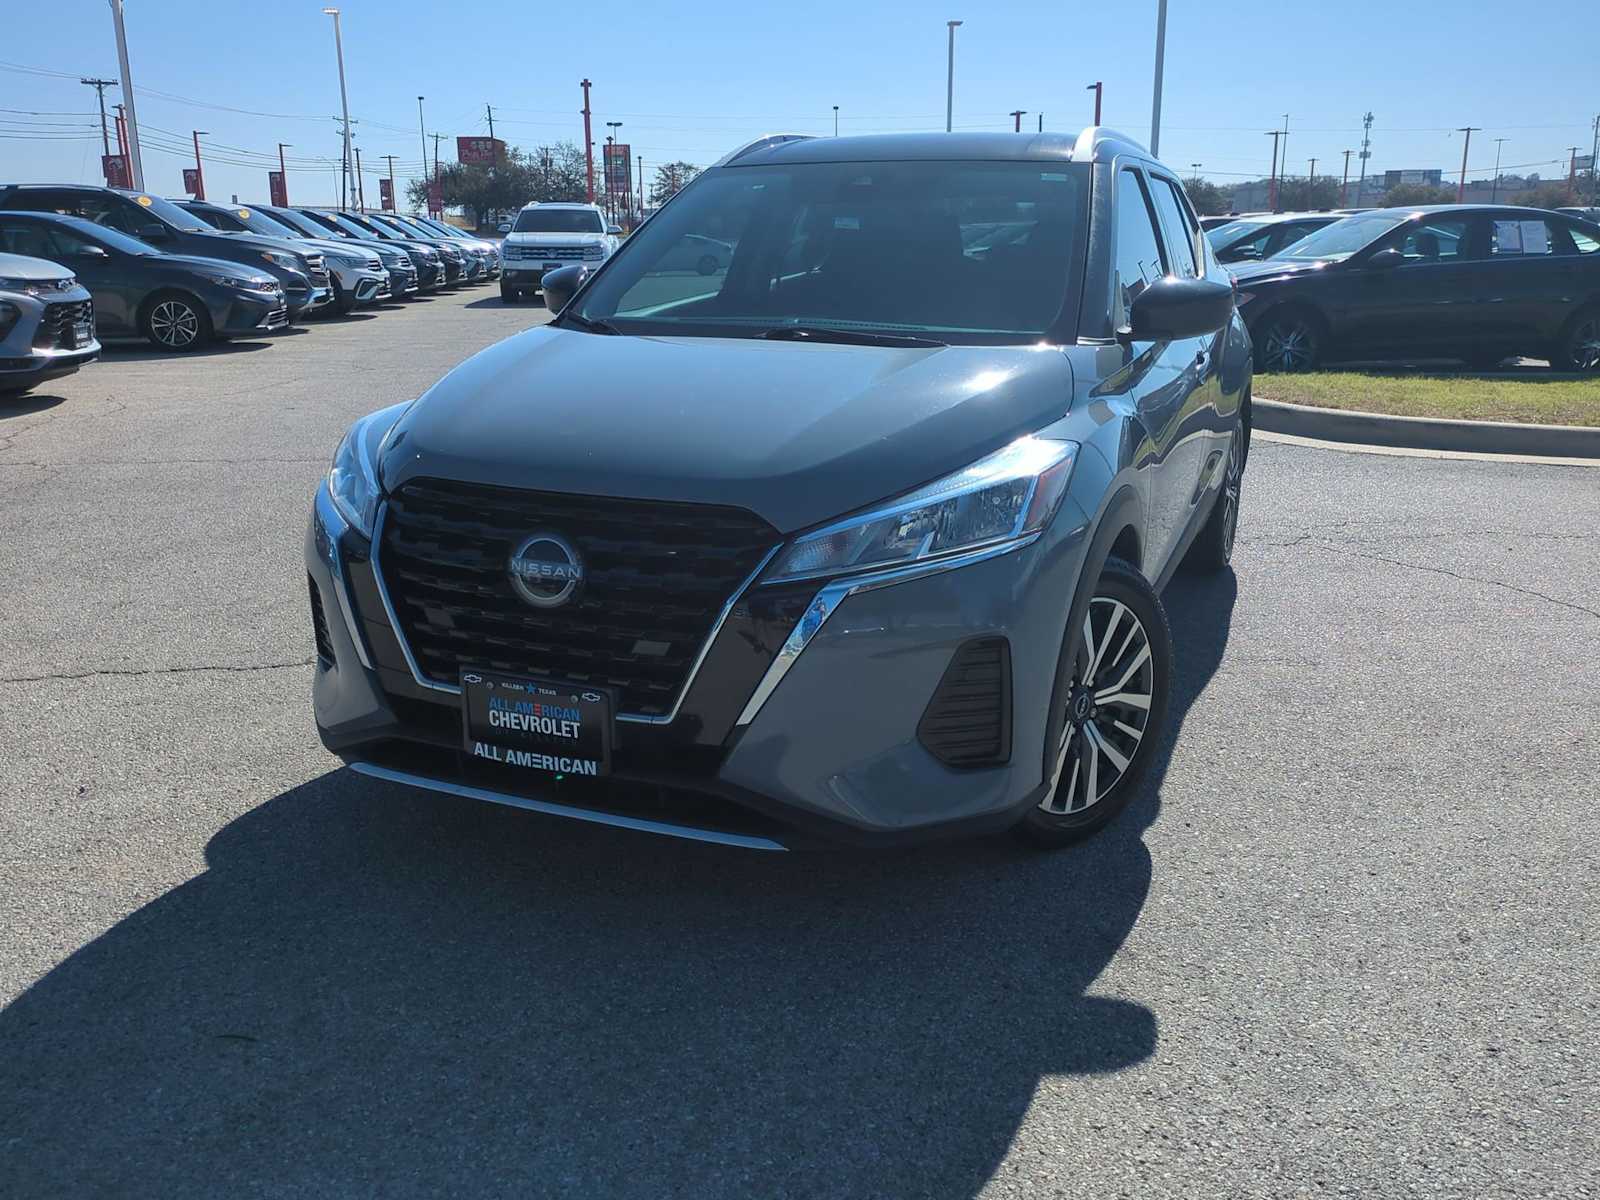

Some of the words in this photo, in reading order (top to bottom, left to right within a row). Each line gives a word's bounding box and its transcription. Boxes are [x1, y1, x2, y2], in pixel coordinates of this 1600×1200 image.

[512, 559, 580, 577] NISSAN
[538, 687, 557, 696] TEXAS
[489, 697, 513, 711] ALL
[515, 701, 581, 721] AMERICAN
[489, 709, 581, 739] CHEVROLET
[474, 742, 503, 762] ALL
[505, 749, 598, 776] AMERICAN
